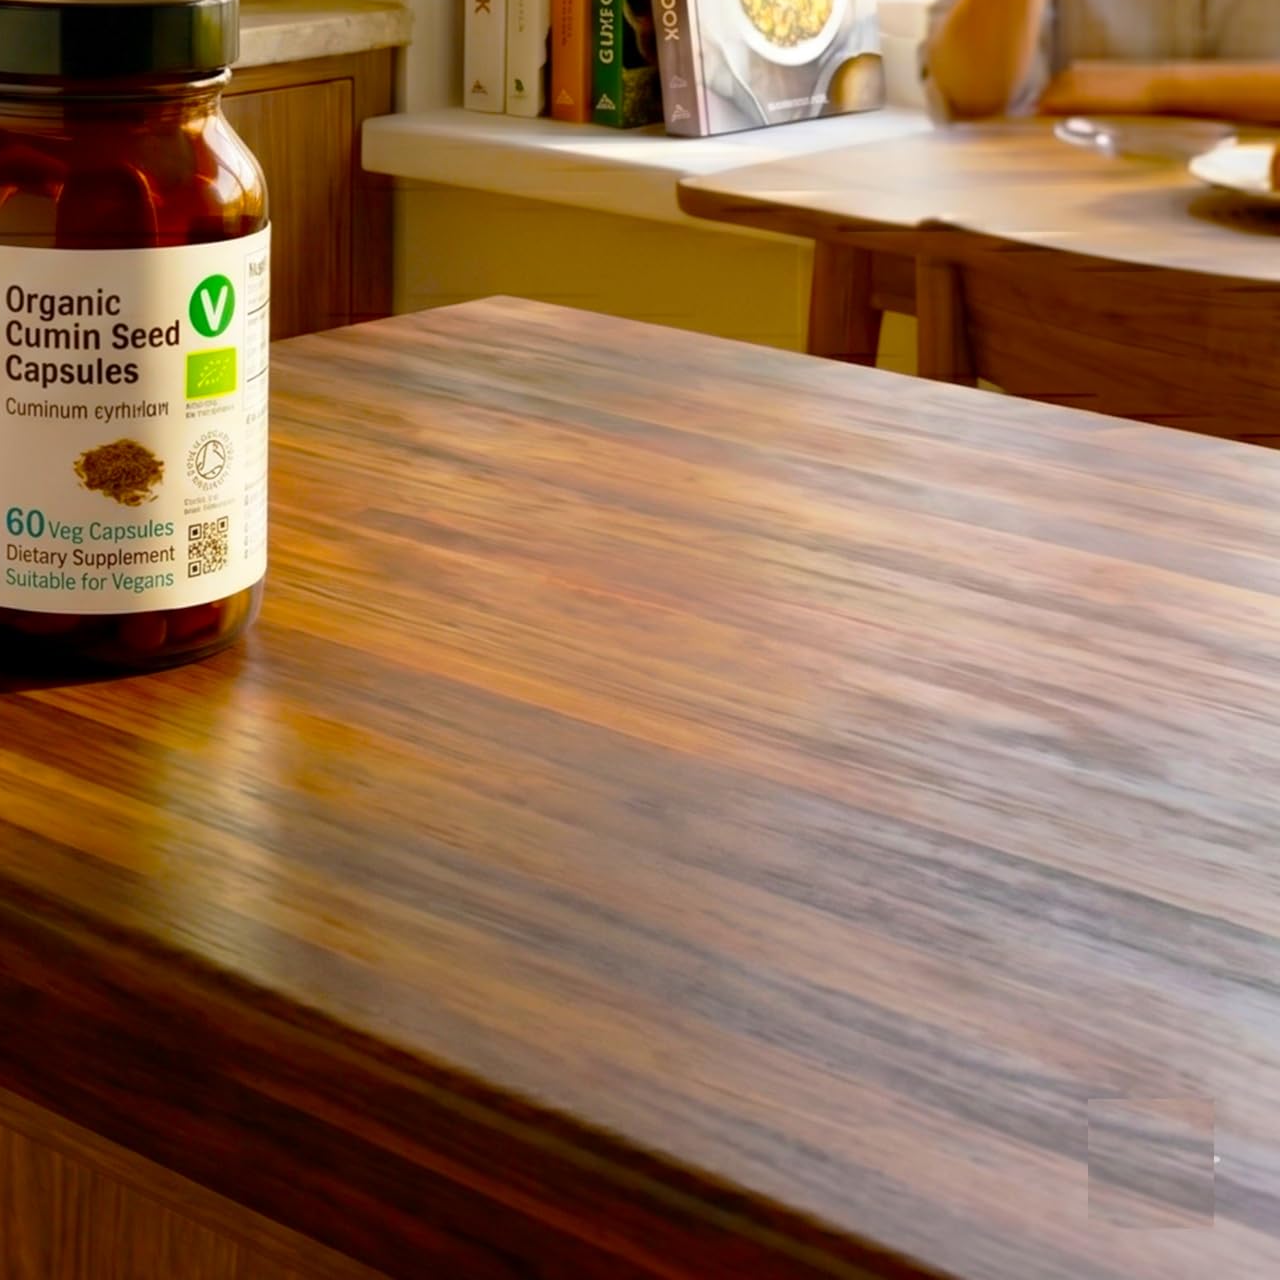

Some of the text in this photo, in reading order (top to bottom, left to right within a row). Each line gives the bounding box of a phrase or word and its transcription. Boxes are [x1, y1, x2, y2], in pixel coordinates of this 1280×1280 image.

[6, 284, 121, 322] Organic
[6, 319, 180, 350] Cumin Seed
[6, 354, 139, 389] Capsules
[6, 397, 88, 420] Cuminum
[6, 507, 175, 545] 60 Veg Capsules
[6, 544, 176, 570] Dietary Supplement
[6, 568, 175, 594] Suitable for Vegans
